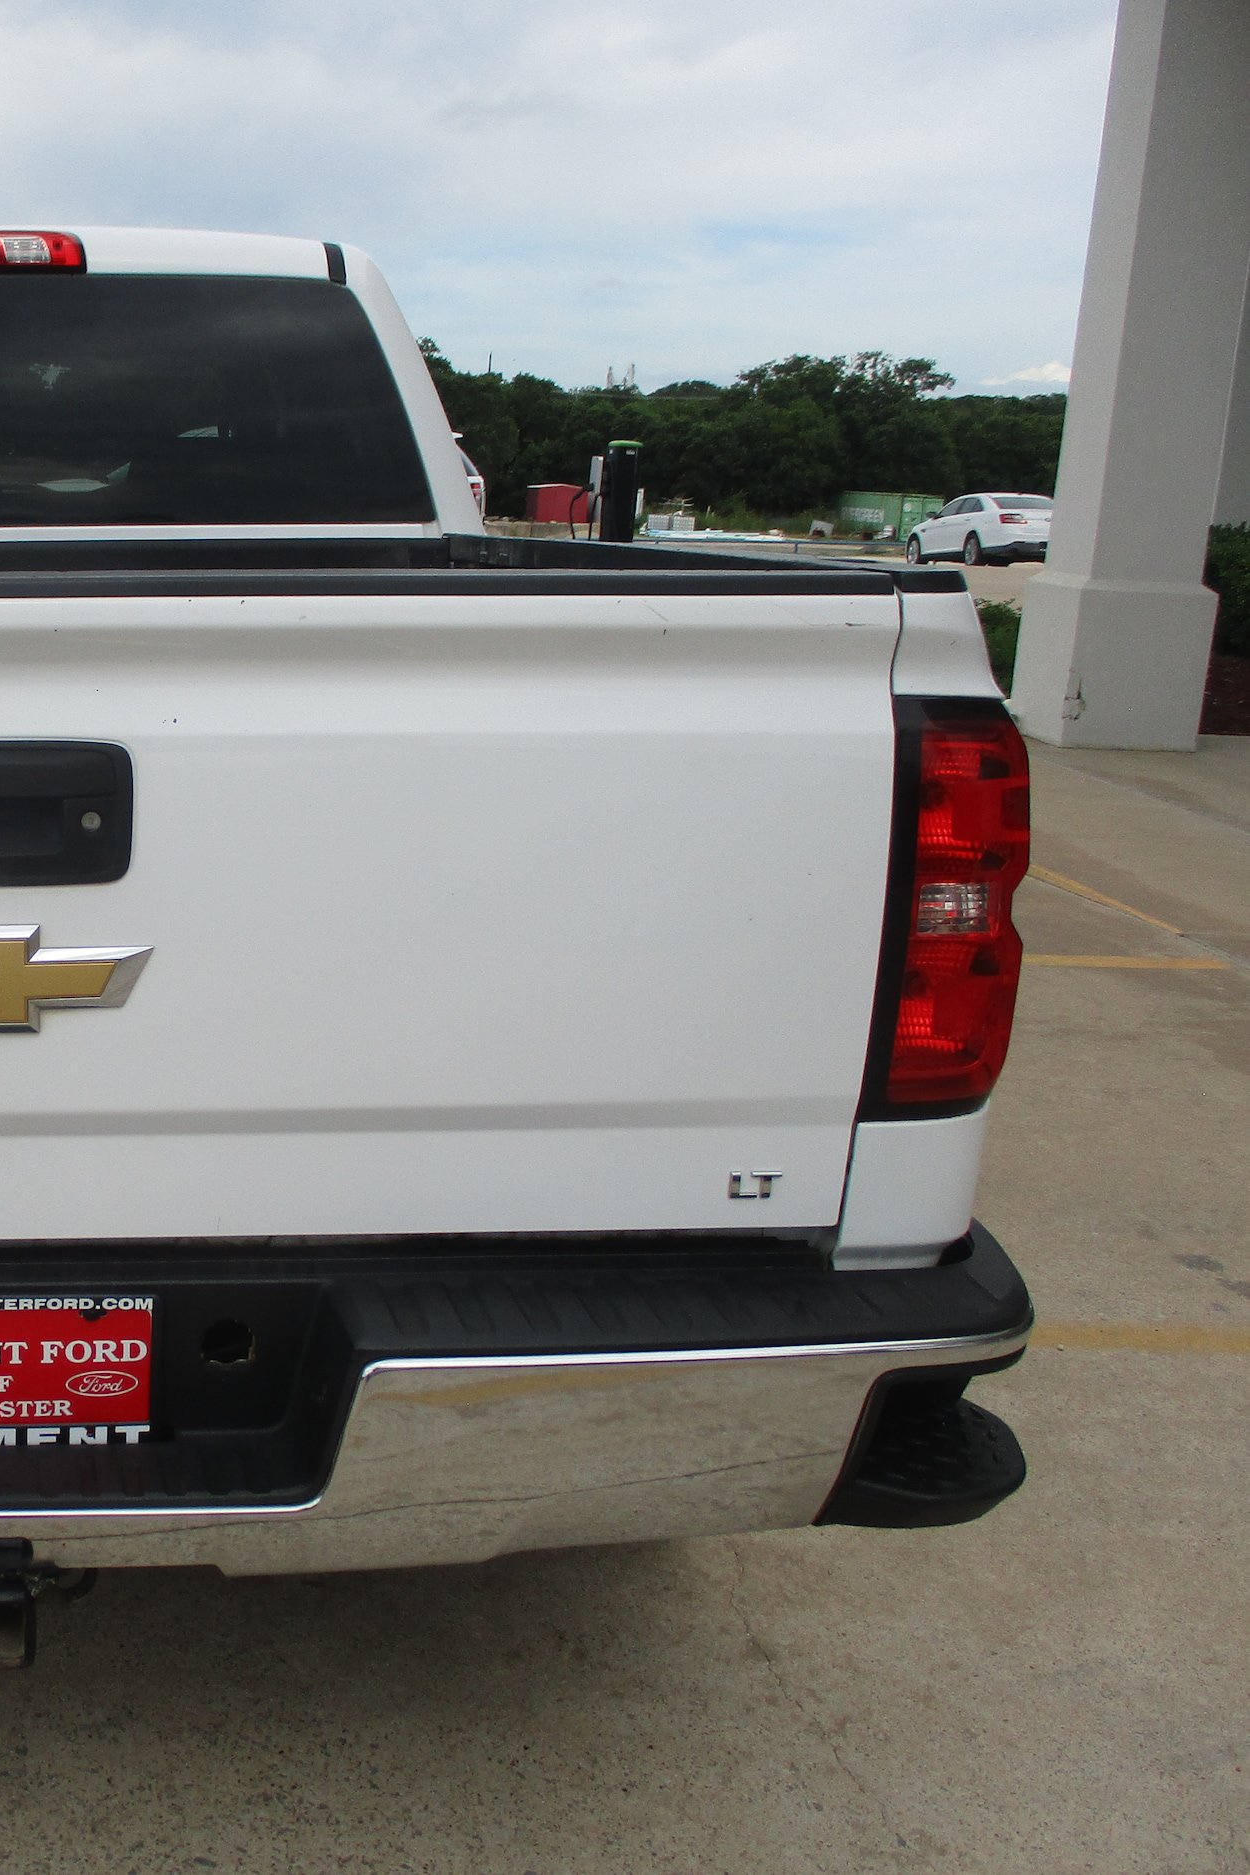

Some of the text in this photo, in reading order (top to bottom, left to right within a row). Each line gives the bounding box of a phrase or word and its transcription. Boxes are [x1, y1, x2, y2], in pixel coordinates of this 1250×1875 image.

[729, 1171, 783, 1199] LT
[40, 1339, 148, 1364] FORD
[78, 1374, 124, 1393] Ford
